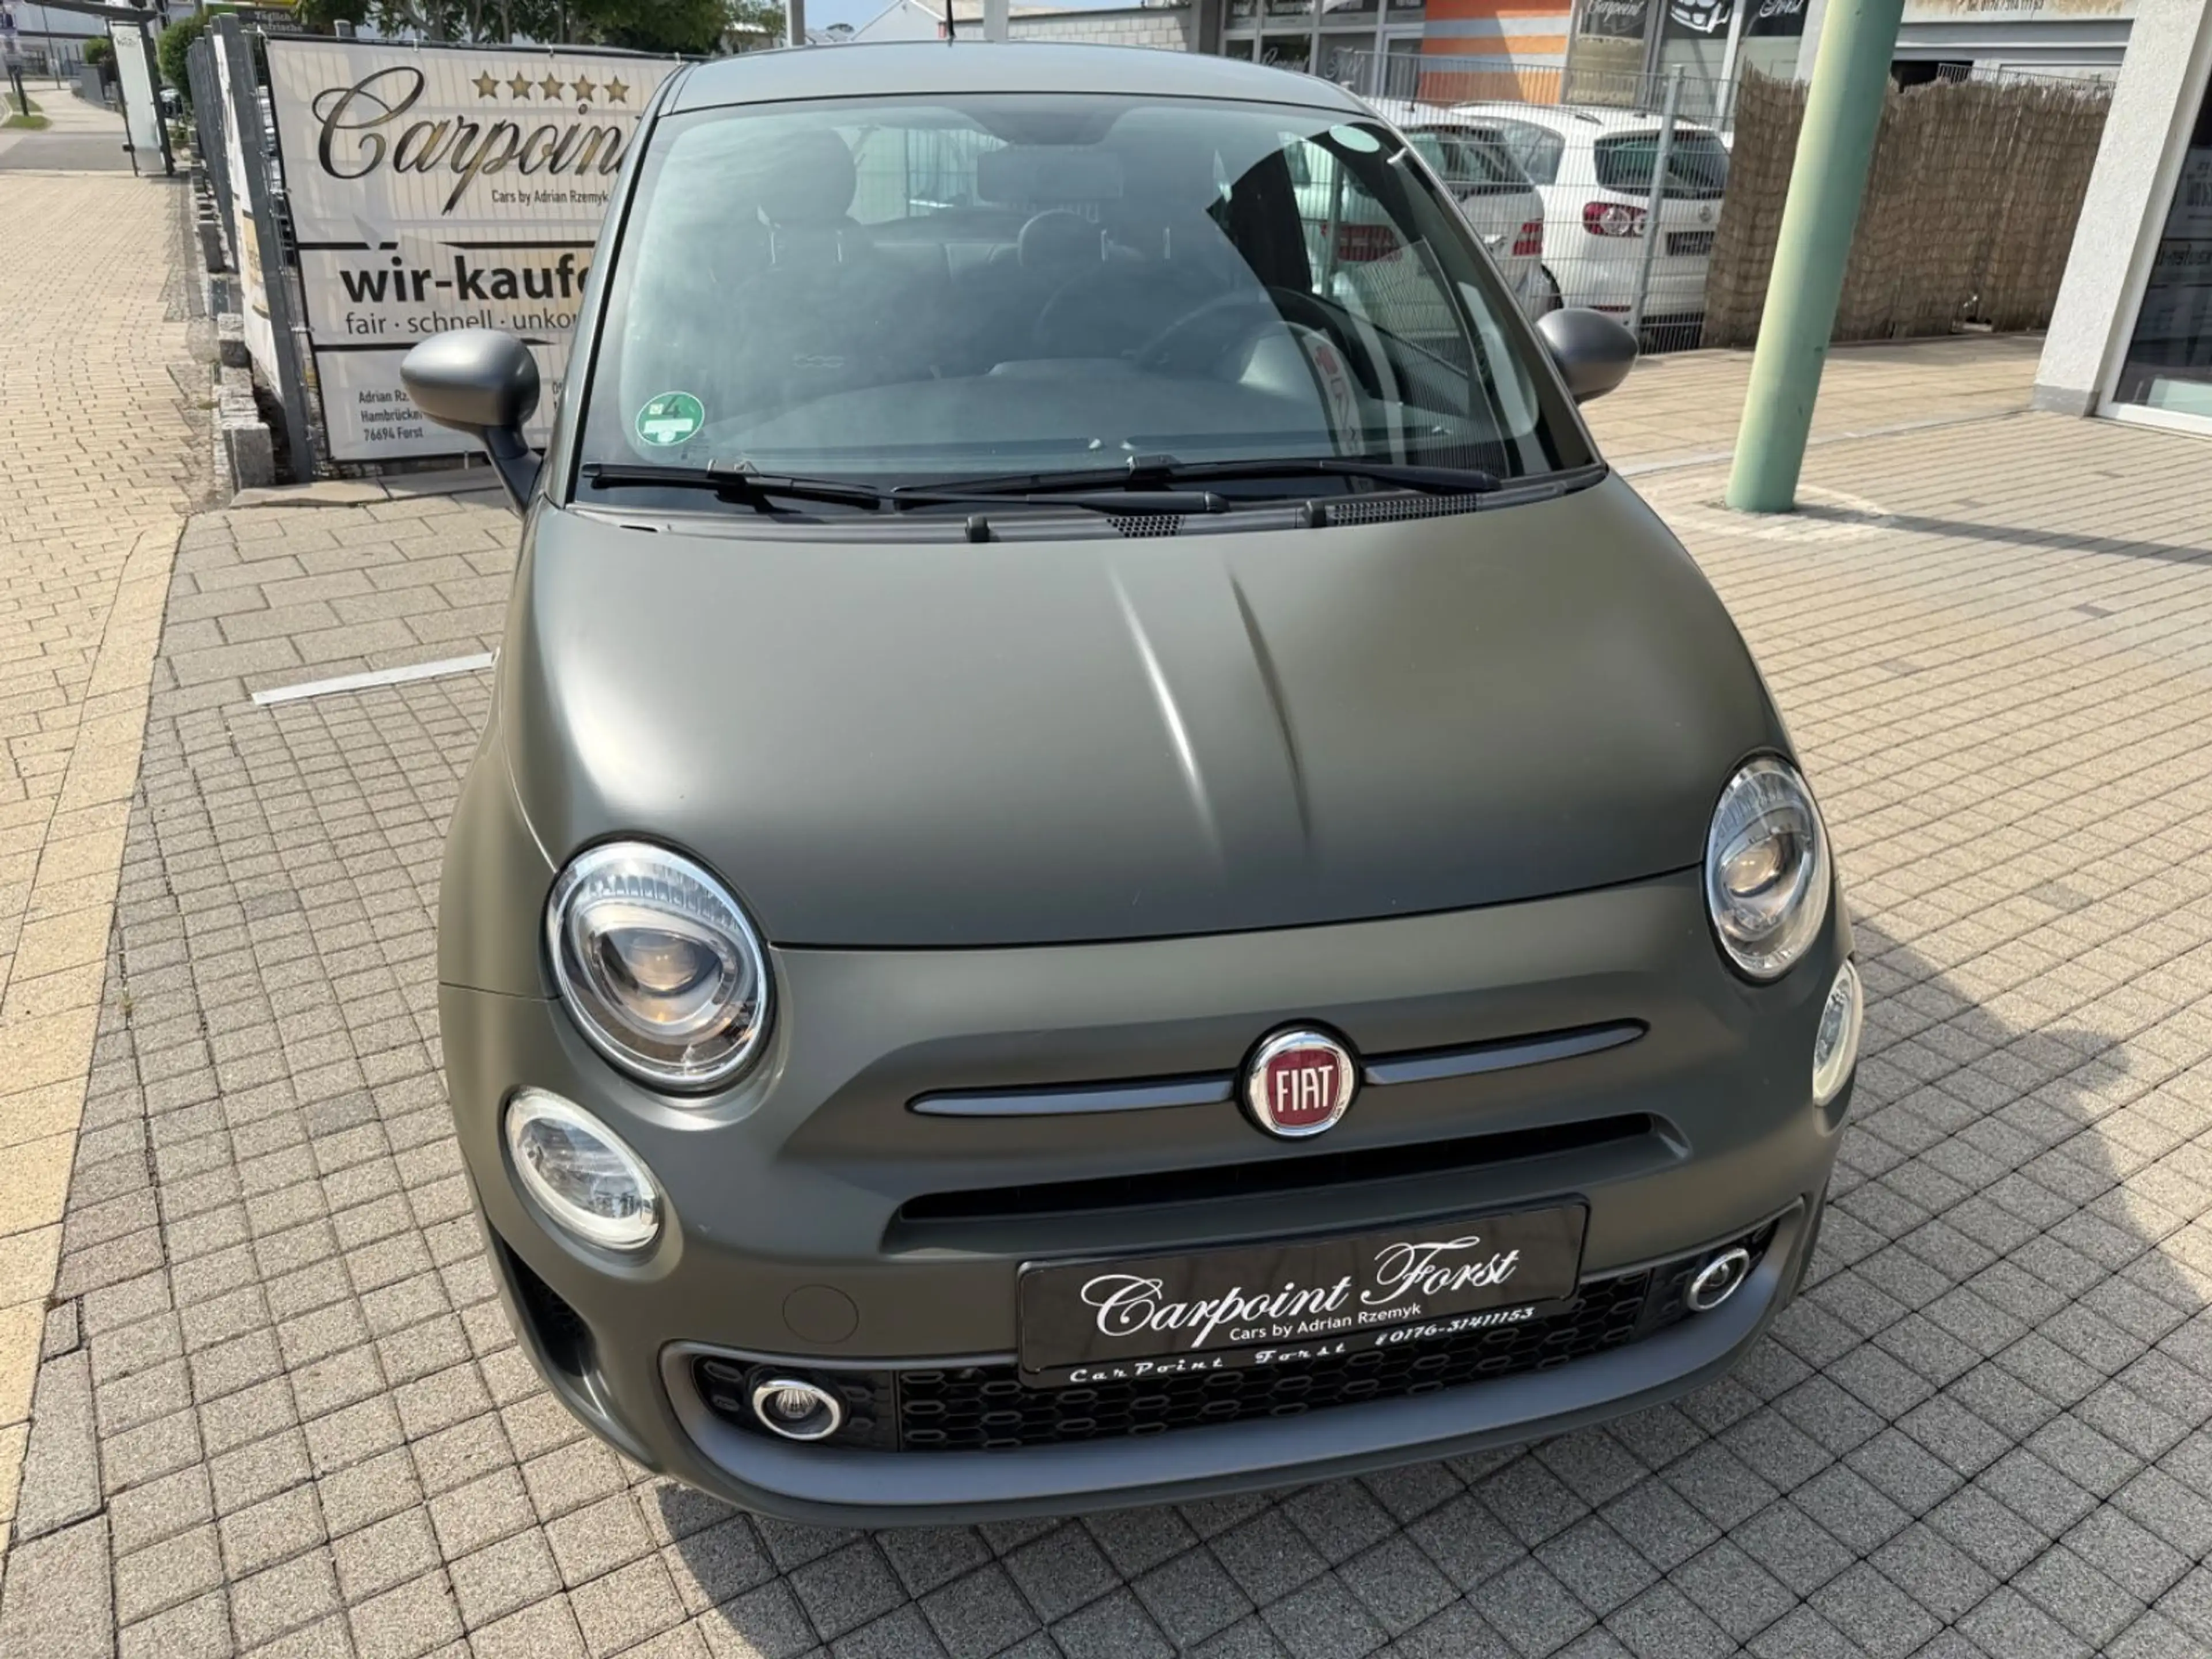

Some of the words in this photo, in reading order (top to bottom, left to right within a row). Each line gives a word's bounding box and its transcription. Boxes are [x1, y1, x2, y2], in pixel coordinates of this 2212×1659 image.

[312, 66, 641, 215] Carpoin
[491, 189, 516, 202] Cars
[518, 189, 531, 206] by
[534, 189, 567, 203] Adrian
[569, 189, 609, 207] Rzemyk
[346, 312, 387, 334] fair
[408, 309, 492, 334] schnell
[514, 306, 577, 329] unko
[359, 390, 393, 403] Adrian
[395, 389, 410, 402] Rz
[662, 395, 681, 419] 4
[363, 427, 395, 441] 76694
[397, 426, 424, 440] Forst
[1275, 1065, 1334, 1112] FIAT
[1081, 1274, 1352, 1348] Carpoint
[1361, 1236, 1520, 1305] Forst
[1229, 1327, 1267, 1342] Cars
[1272, 1324, 1292, 1339] by
[1297, 1316, 1352, 1335] Adrian
[1357, 1302, 1422, 1324] Rzemyk
[1254, 1342, 1346, 1365] Forst
